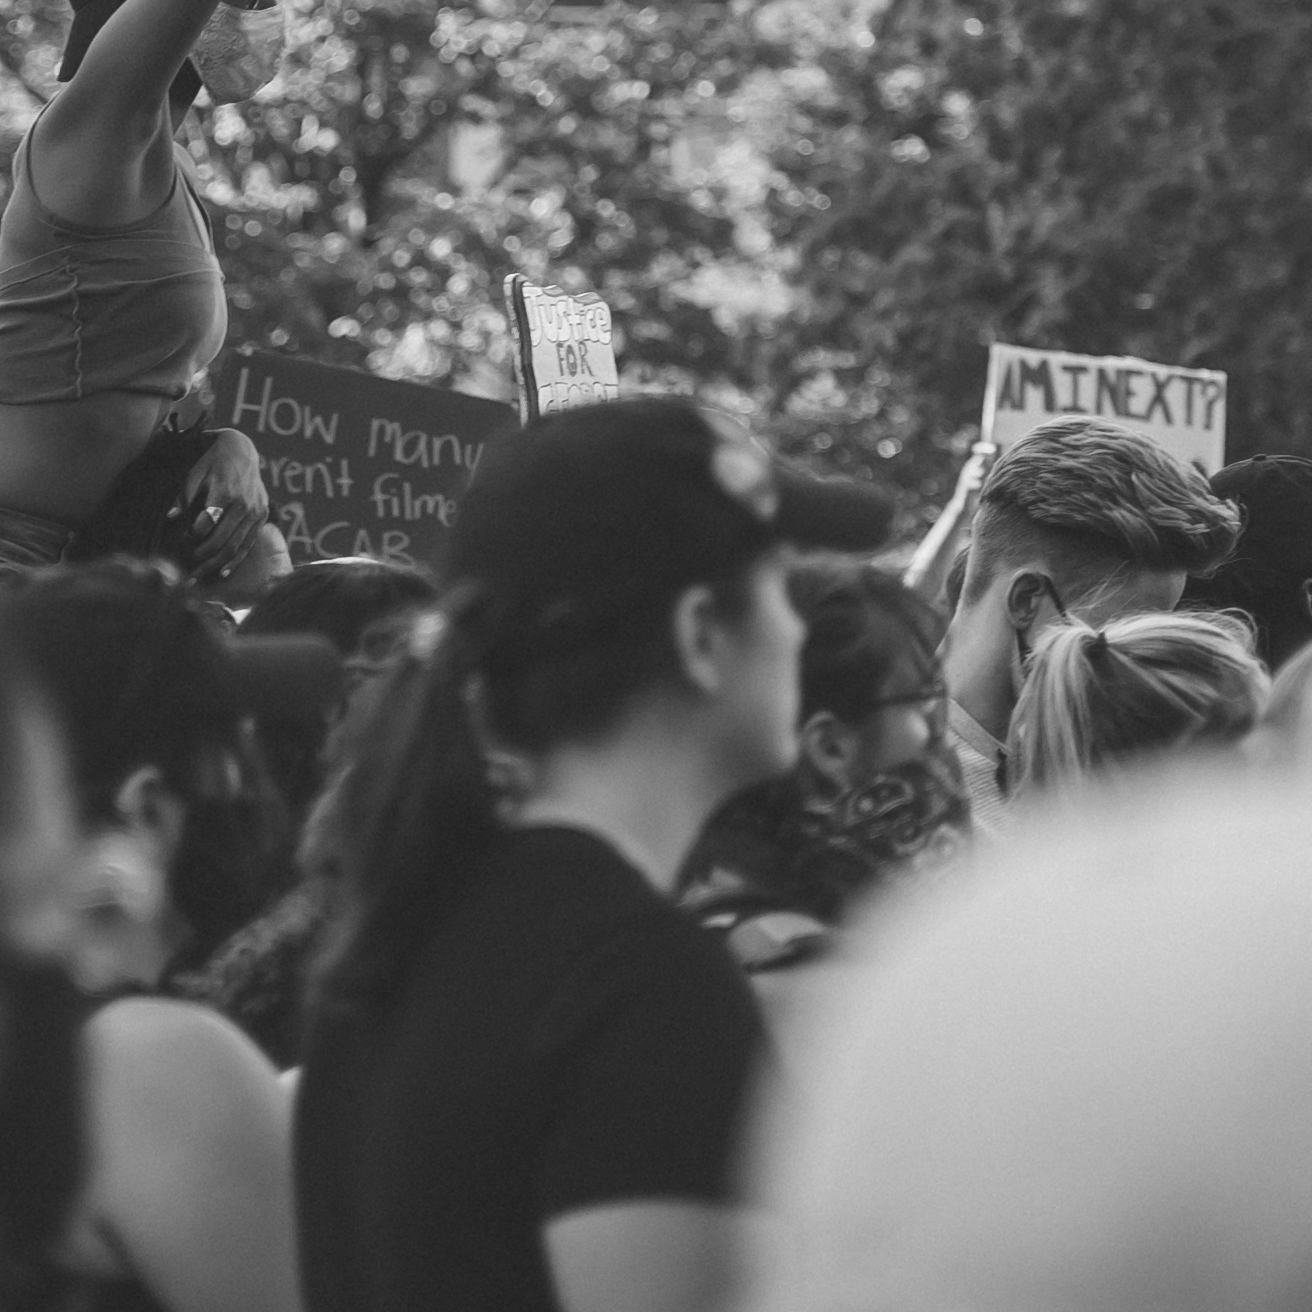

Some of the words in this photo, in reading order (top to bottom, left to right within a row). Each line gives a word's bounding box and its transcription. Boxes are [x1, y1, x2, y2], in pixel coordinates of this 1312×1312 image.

[556, 340, 595, 378] FOR
[232, 367, 339, 445] How
[367, 417, 485, 488] many
[996, 356, 1056, 413] AM
[1059, 364, 1089, 414] I
[1094, 366, 1225, 431] NEXT?
[258, 454, 355, 498] ren't
[278, 500, 417, 568] ACAB
